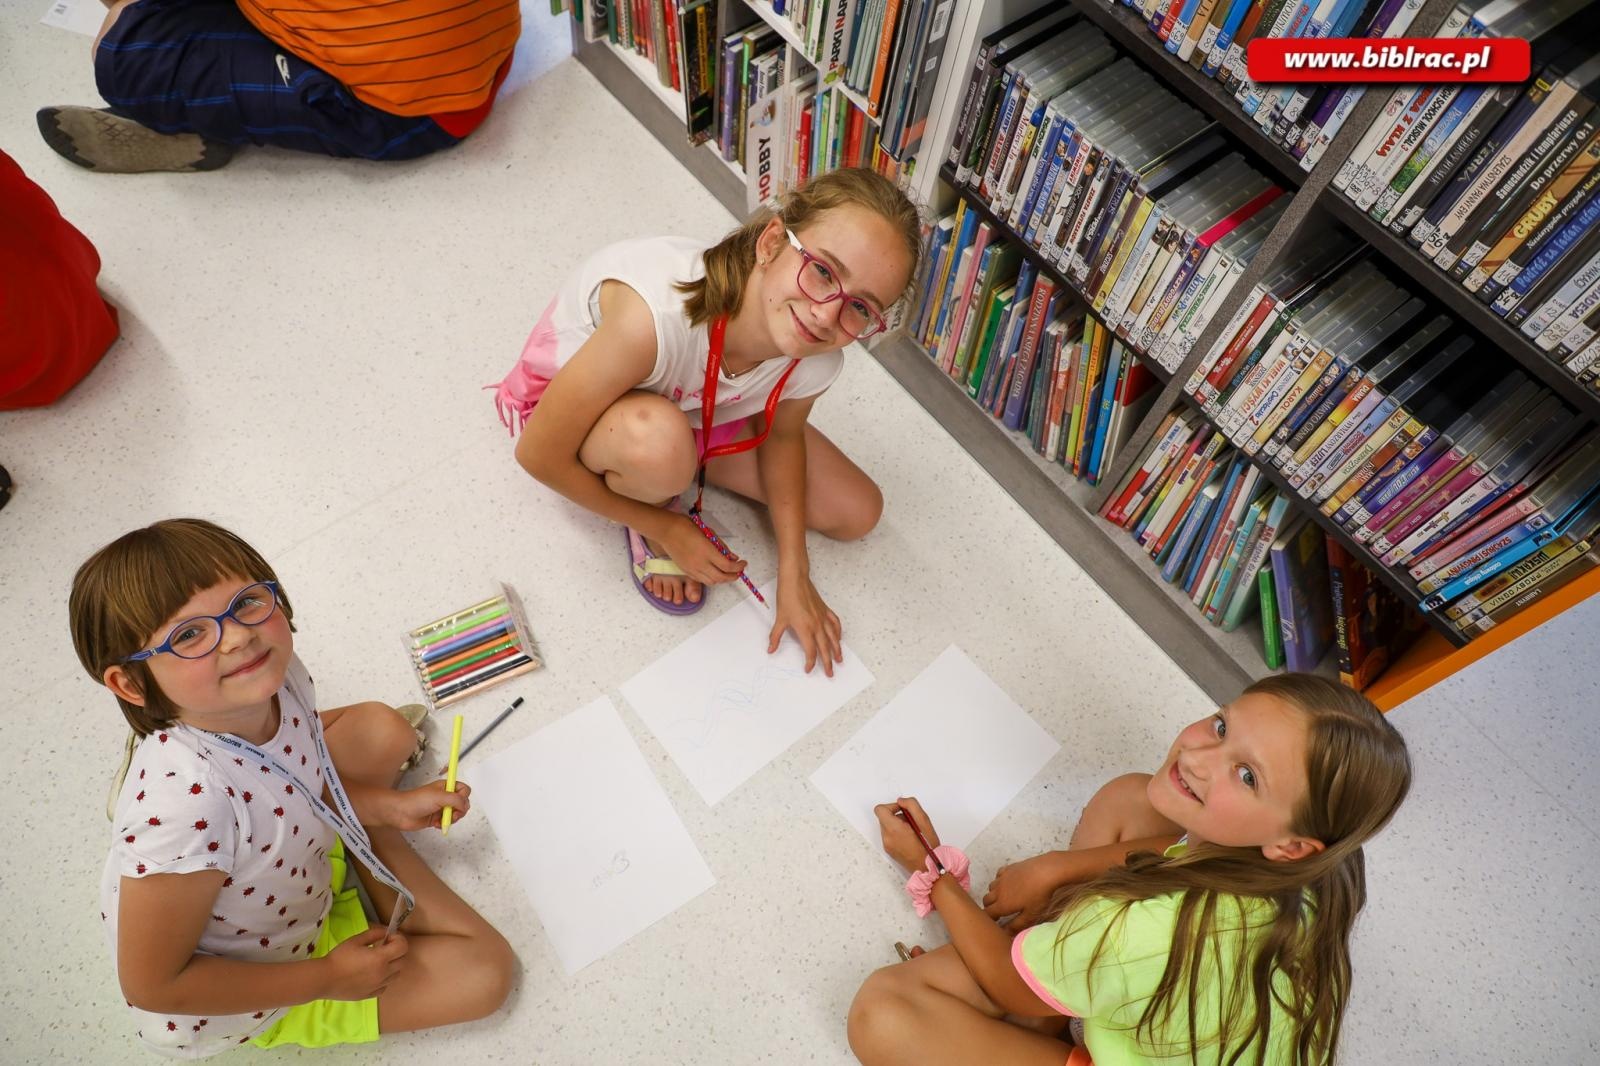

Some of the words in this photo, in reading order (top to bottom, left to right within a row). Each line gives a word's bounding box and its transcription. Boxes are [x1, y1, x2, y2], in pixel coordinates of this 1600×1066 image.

[828, 29, 841, 71] PARKI
[1001, 97, 1016, 132] GRUBY
[1401, 113, 1413, 125] Z
[1421, 96, 1444, 123] SCHOOL
[1013, 114, 1030, 146] Marley
[1403, 119, 1427, 148] MUSICAL
[989, 133, 1005, 170] ALBERT
[1456, 137, 1498, 185] TERRA
[1495, 155, 1535, 200] Samochodzik
[1533, 107, 1578, 156] templariusze
[1529, 174, 1545, 191] Do
[1542, 137, 1580, 178] przerwy
[758, 136, 772, 201] HOBBY
[1476, 153, 1512, 193] SZALEŃSTWA
[1082, 187, 1096, 211] ZEMSTA
[1453, 204, 1468, 220] EWY
[1462, 187, 1483, 210] PANNY
[1558, 186, 1587, 216] przygody
[1511, 189, 1559, 241] GRUBY
[1426, 231, 1445, 249] 56
[1515, 255, 1548, 288] Podróż
[1553, 221, 1582, 250] jeden
[1161, 268, 1187, 309] PRZYGODY
[1185, 272, 1205, 298] HOTEL
[1028, 287, 1046, 333] RODZINNA
[1011, 362, 1026, 399] ZAGADEK
[1259, 358, 1286, 388] WIELKI
[1239, 385, 1265, 414] WYŚCI
[1279, 385, 1303, 412] KAROL
[1350, 383, 1370, 403] DUMA
[1248, 415, 1260, 426] 2
[1309, 397, 1334, 424] MIASTO
[1489, 588, 1515, 607] OGNIA
[1336, 614, 1346, 632] księga
